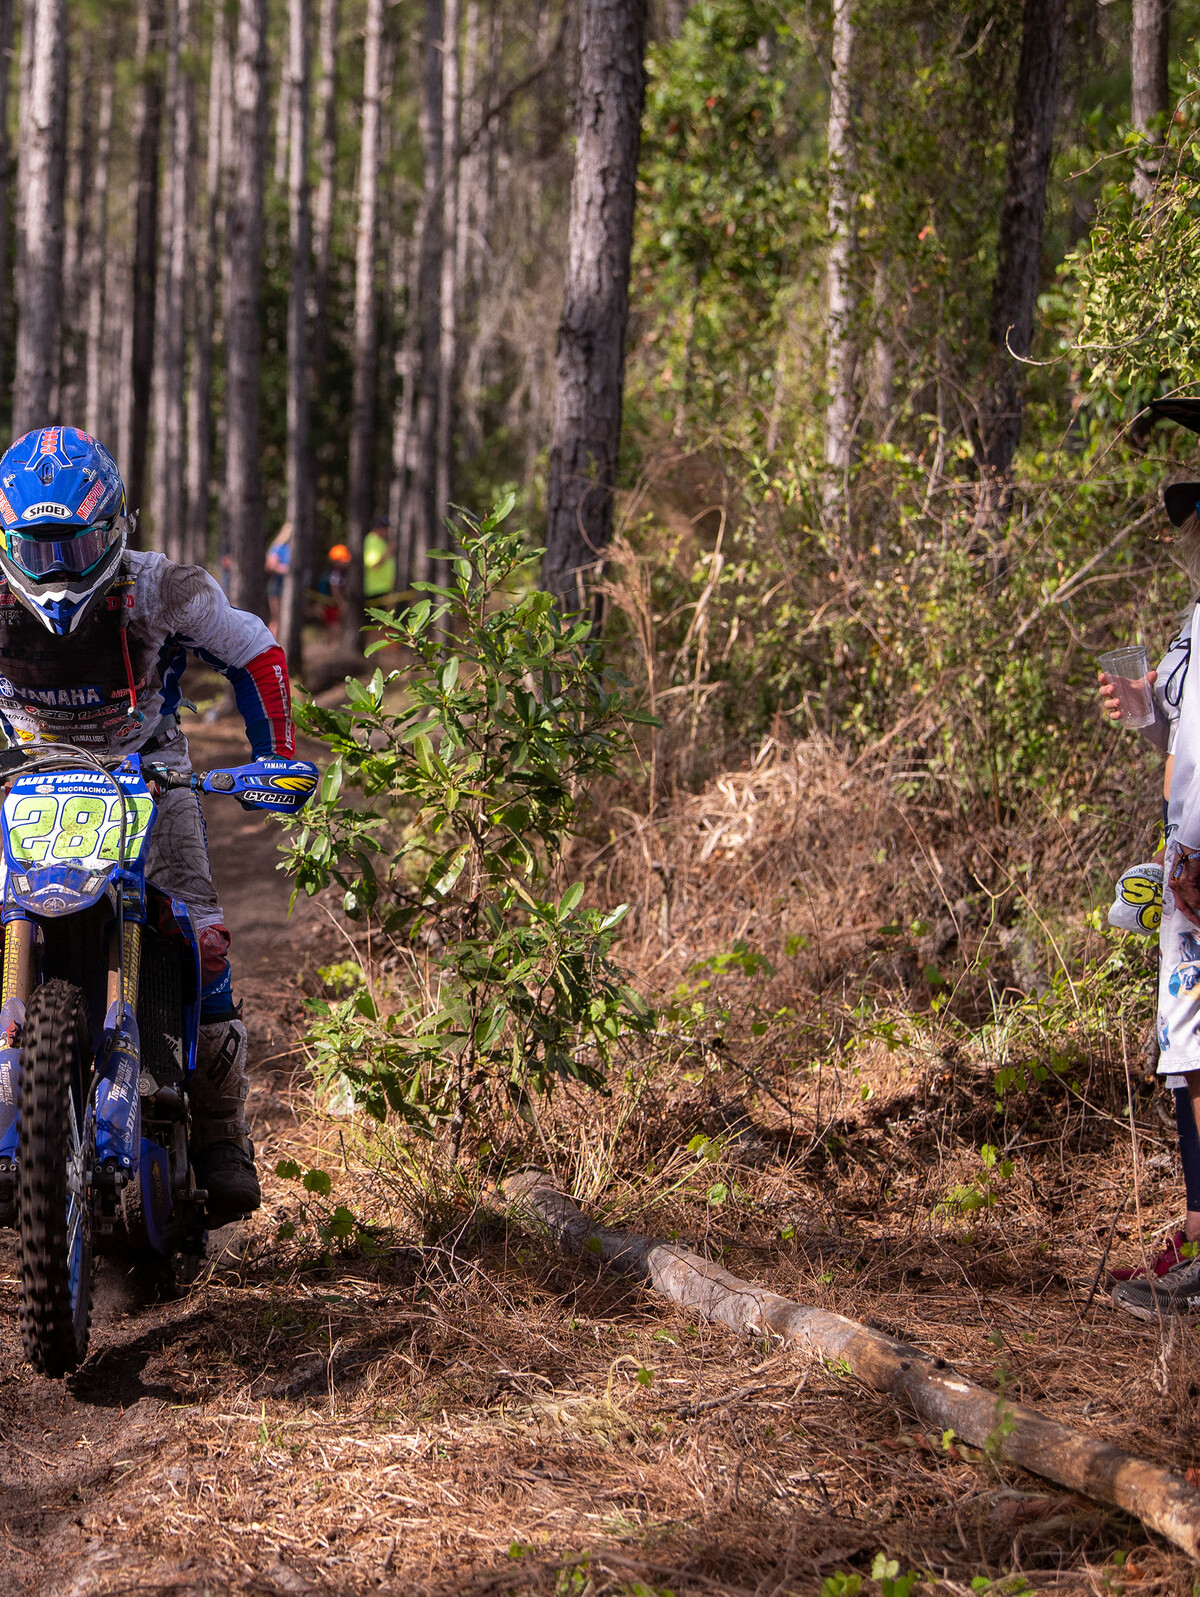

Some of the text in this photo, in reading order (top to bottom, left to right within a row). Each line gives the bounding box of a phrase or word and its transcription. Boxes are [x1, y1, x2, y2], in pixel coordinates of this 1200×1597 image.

[29, 503, 66, 517] SHOEI
[14, 685, 100, 707] YAMAHA
[71, 734, 106, 743] YAMALUBE
[264, 762, 287, 770] YAMAHA
[16, 773, 140, 787] WITKOWSKI
[57, 785, 118, 794] GNCCRACING.co
[244, 790, 296, 805] CYCRA
[9, 796, 155, 861] 282
